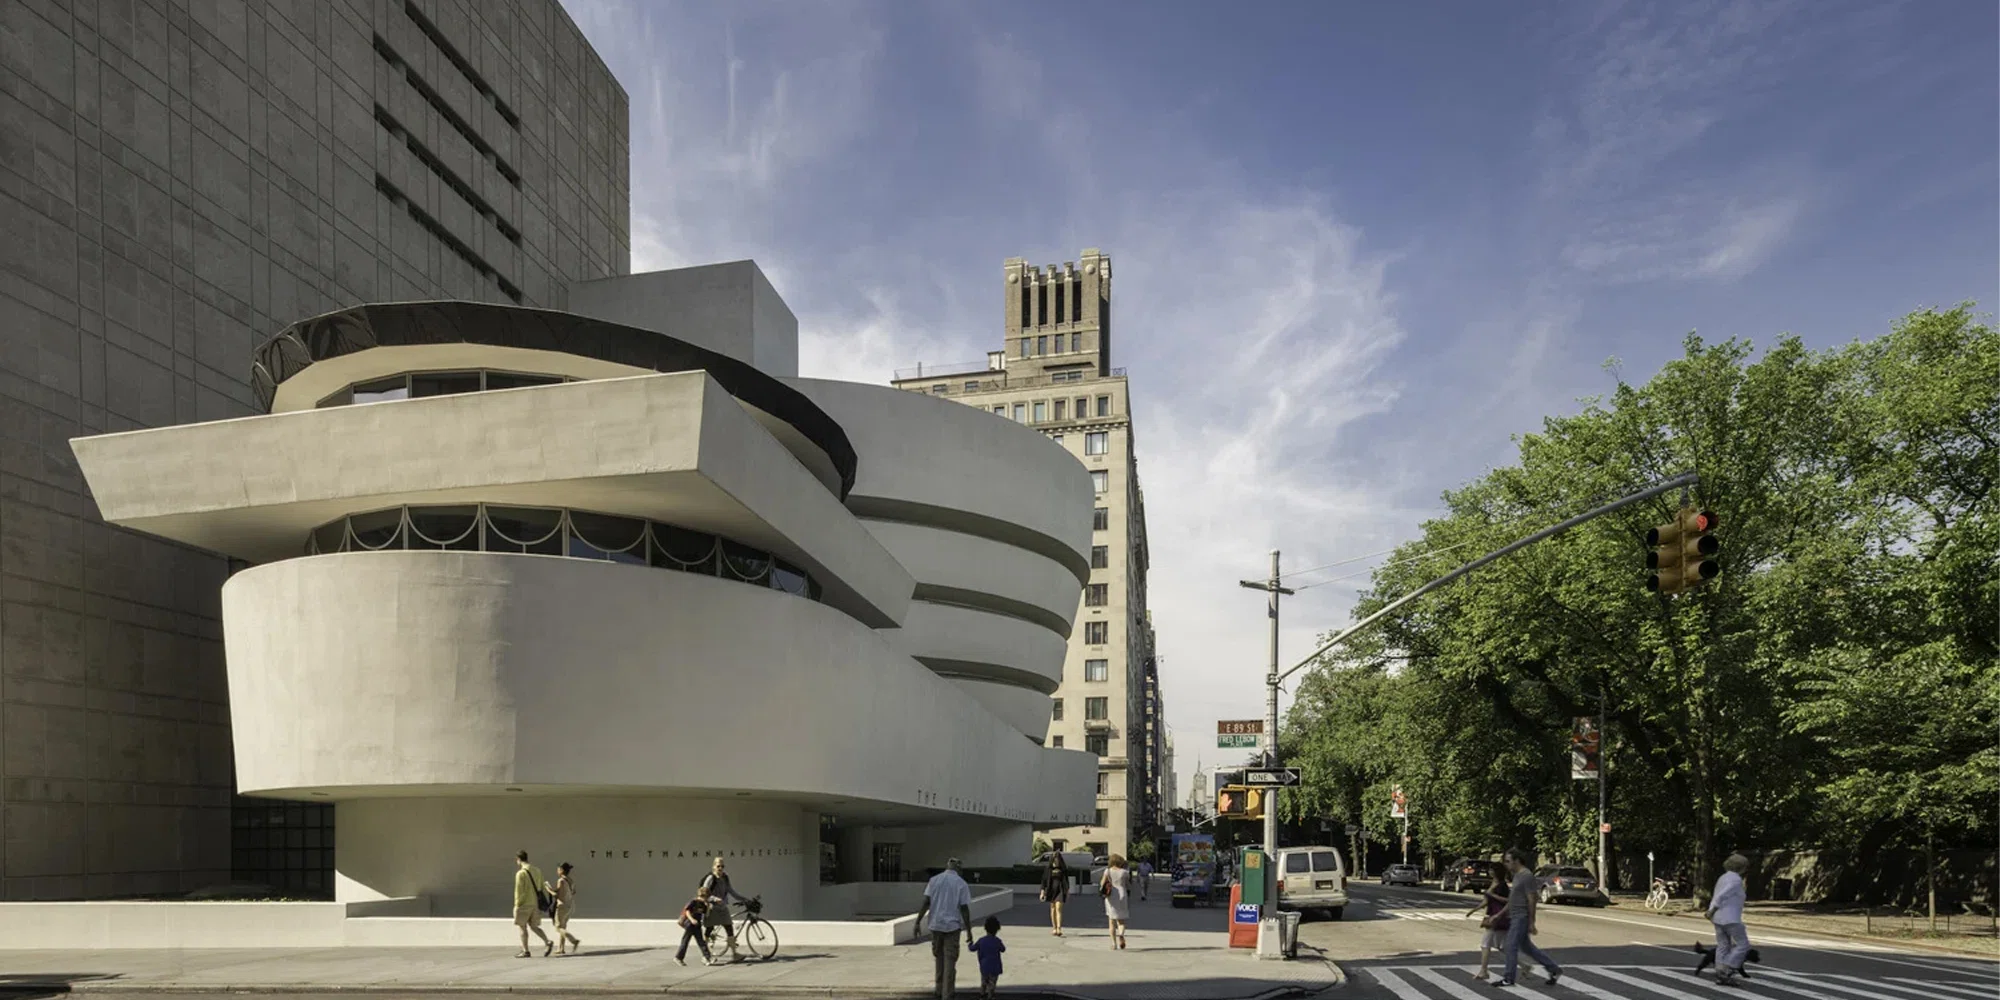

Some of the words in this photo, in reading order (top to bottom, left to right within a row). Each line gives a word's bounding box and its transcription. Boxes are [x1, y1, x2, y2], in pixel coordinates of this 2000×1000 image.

[1226, 724, 1231, 733] E
[1233, 723, 1244, 733] 89
[1247, 723, 1256, 733] St
[1252, 773, 1268, 781] ONE
[917, 789, 937, 806] THE
[589, 850, 630, 859] THE
[1236, 904, 1258, 912] VOICE
